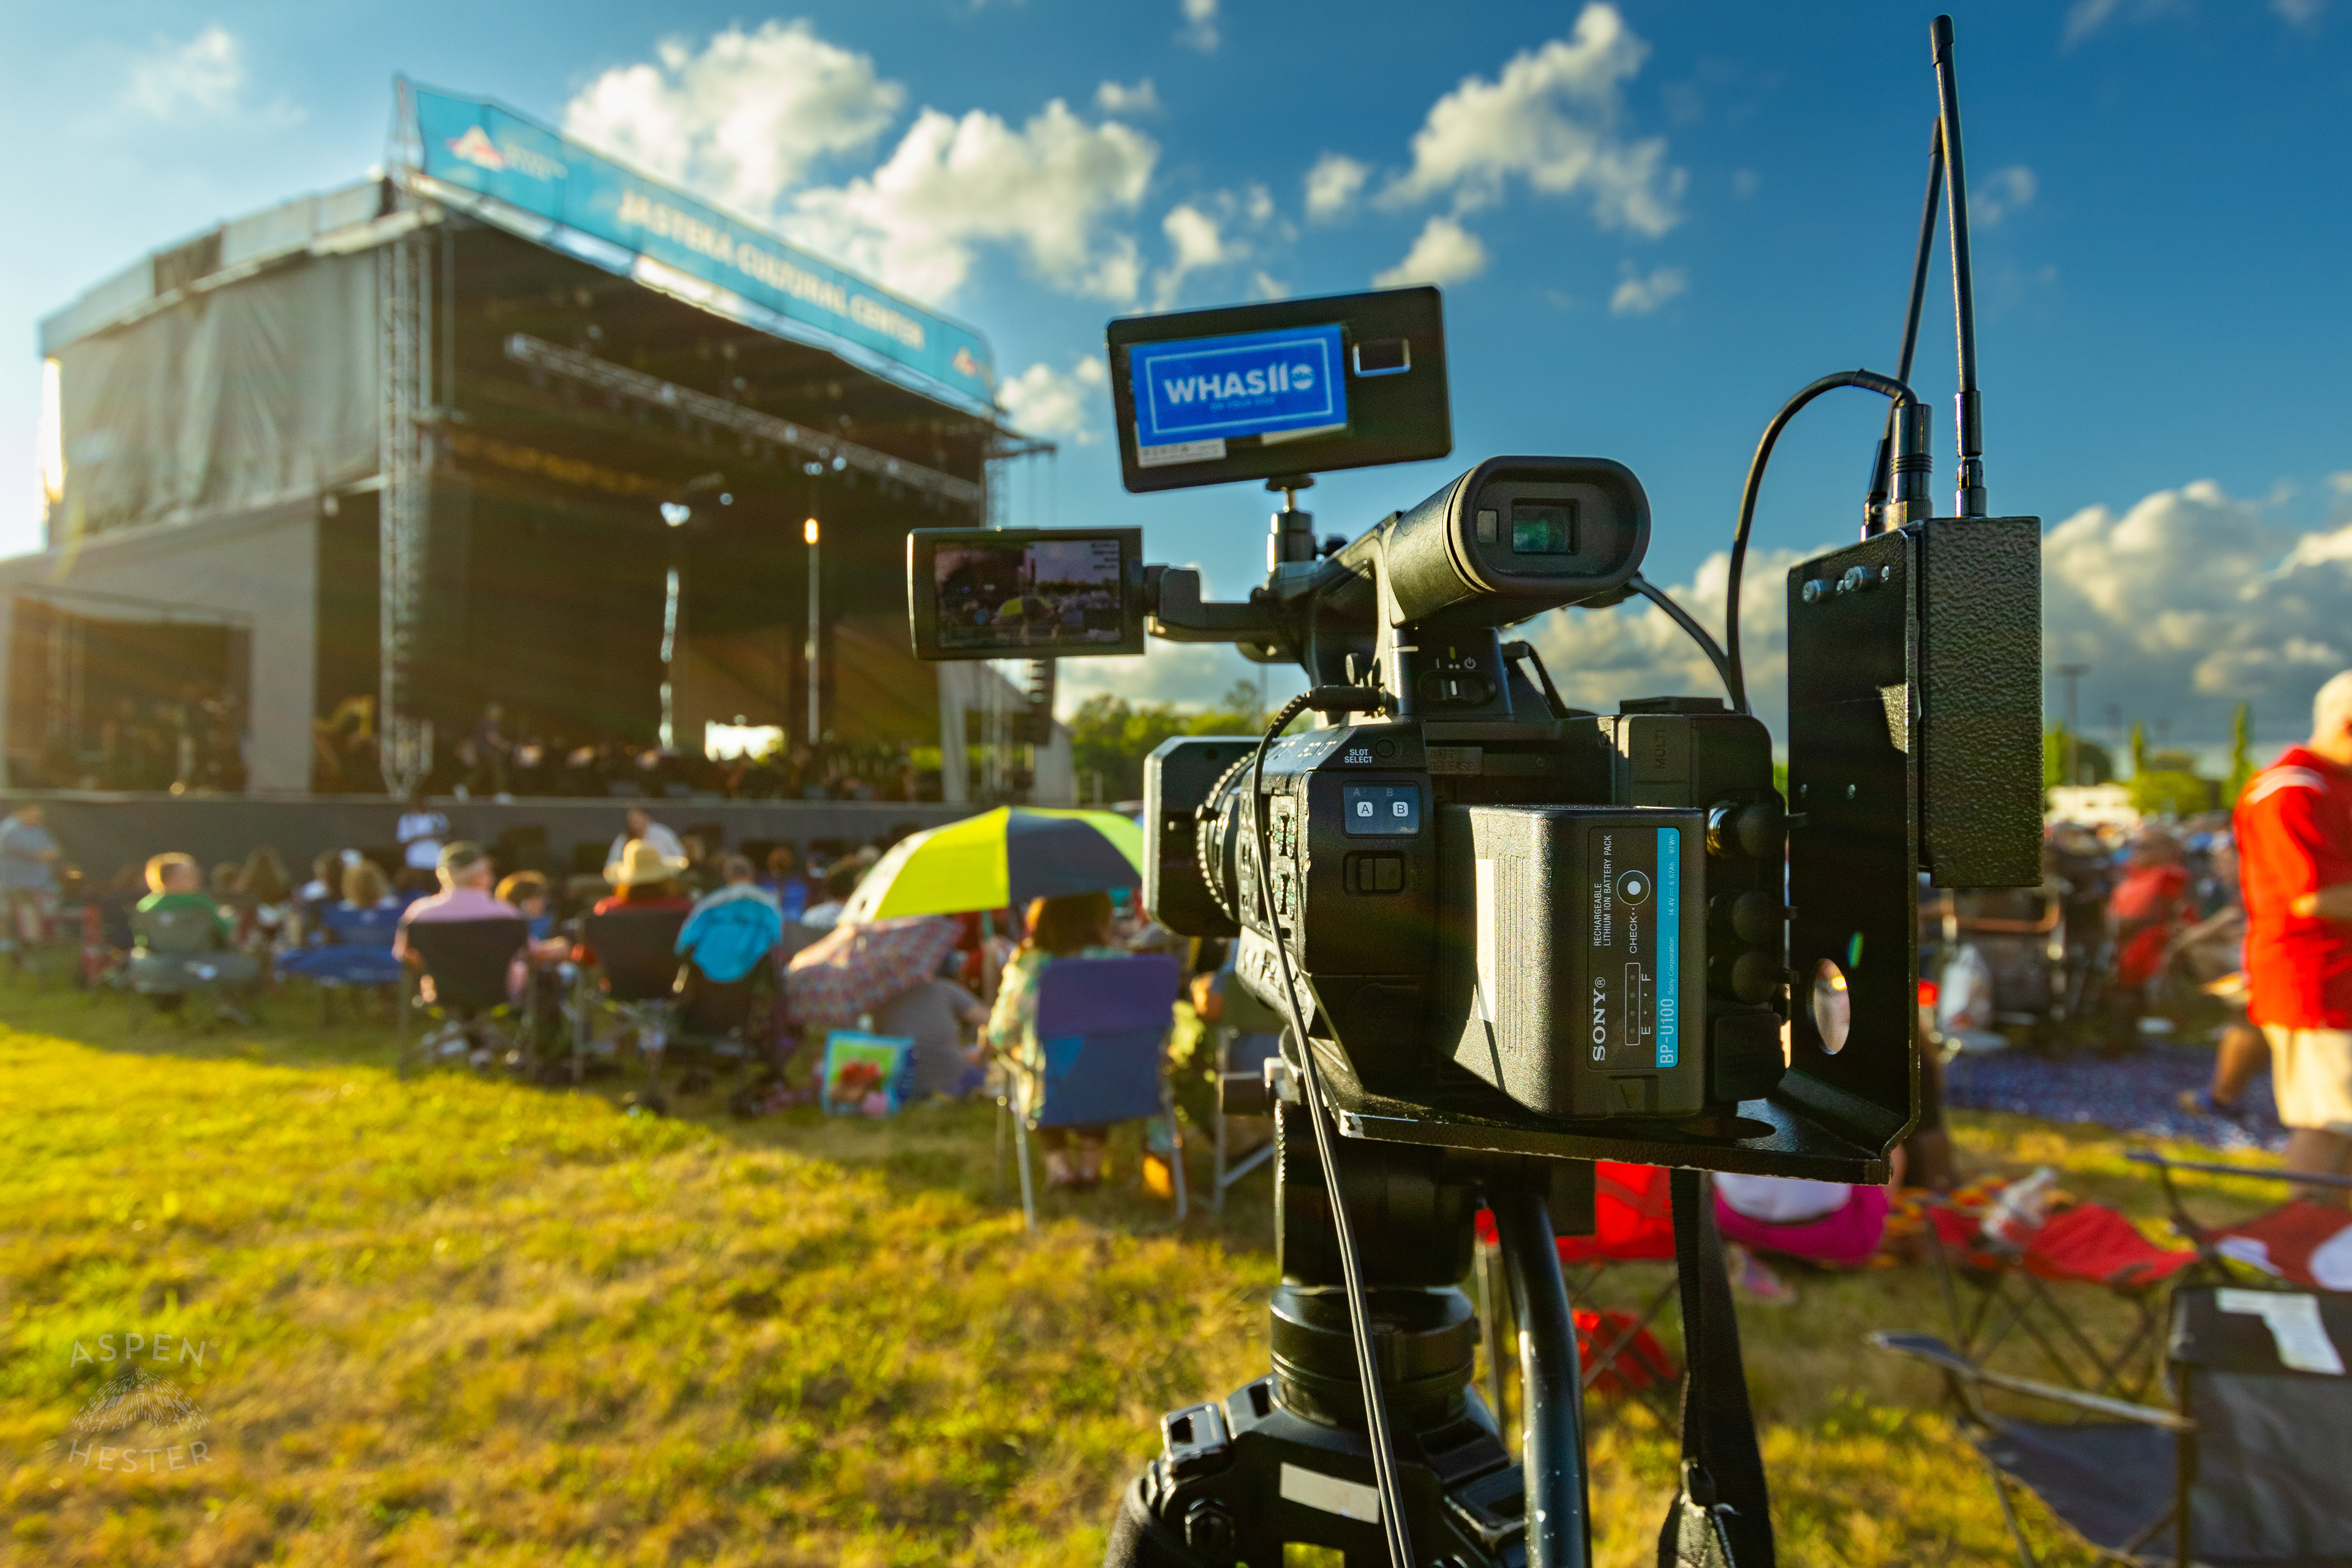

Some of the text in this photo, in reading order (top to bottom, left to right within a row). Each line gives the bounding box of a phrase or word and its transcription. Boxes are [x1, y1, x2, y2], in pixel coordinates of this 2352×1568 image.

[736, 242, 848, 318] CULTURAL
[850, 293, 925, 351] CENTER
[1654, 729, 1667, 770] MULTI
[1361, 804, 1405, 814] A B
[1604, 835, 1612, 856] PACK
[1594, 883, 1602, 946] RECHARGEABLE
[1668, 978, 1676, 995] Sony
[1660, 998, 1675, 1063] BP-U100
